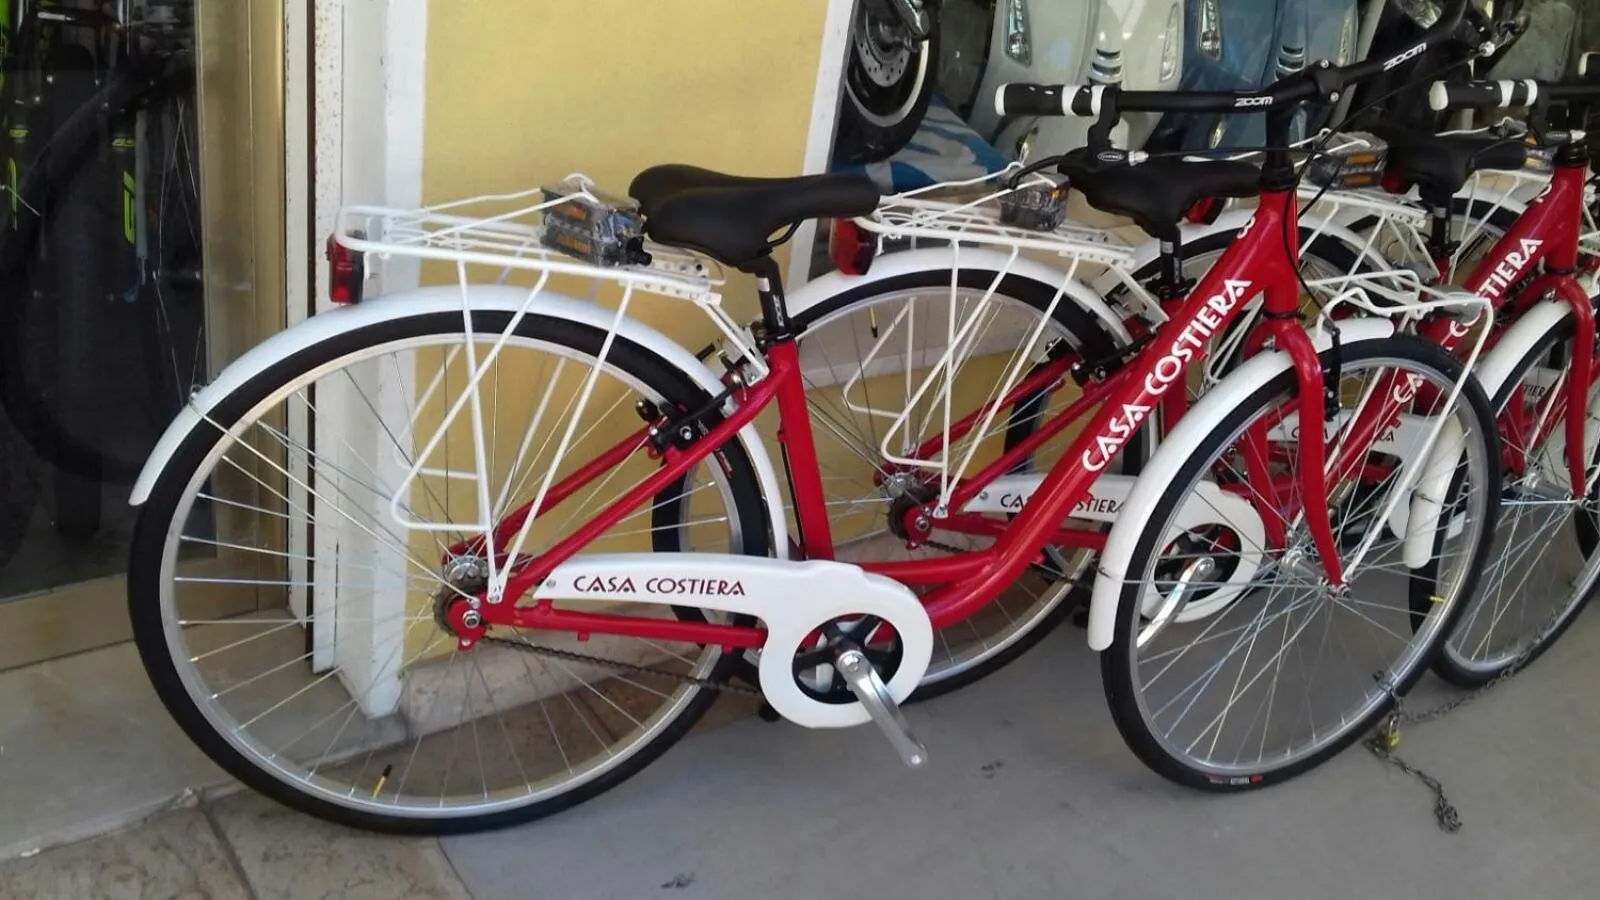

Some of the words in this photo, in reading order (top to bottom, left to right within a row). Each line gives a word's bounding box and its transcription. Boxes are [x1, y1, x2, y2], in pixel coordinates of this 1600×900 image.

[1082, 403, 1151, 472] CASA
[1144, 279, 1252, 395] COSTIERA
[573, 576, 636, 593] CASA
[646, 578, 746, 596] COSTIERA
